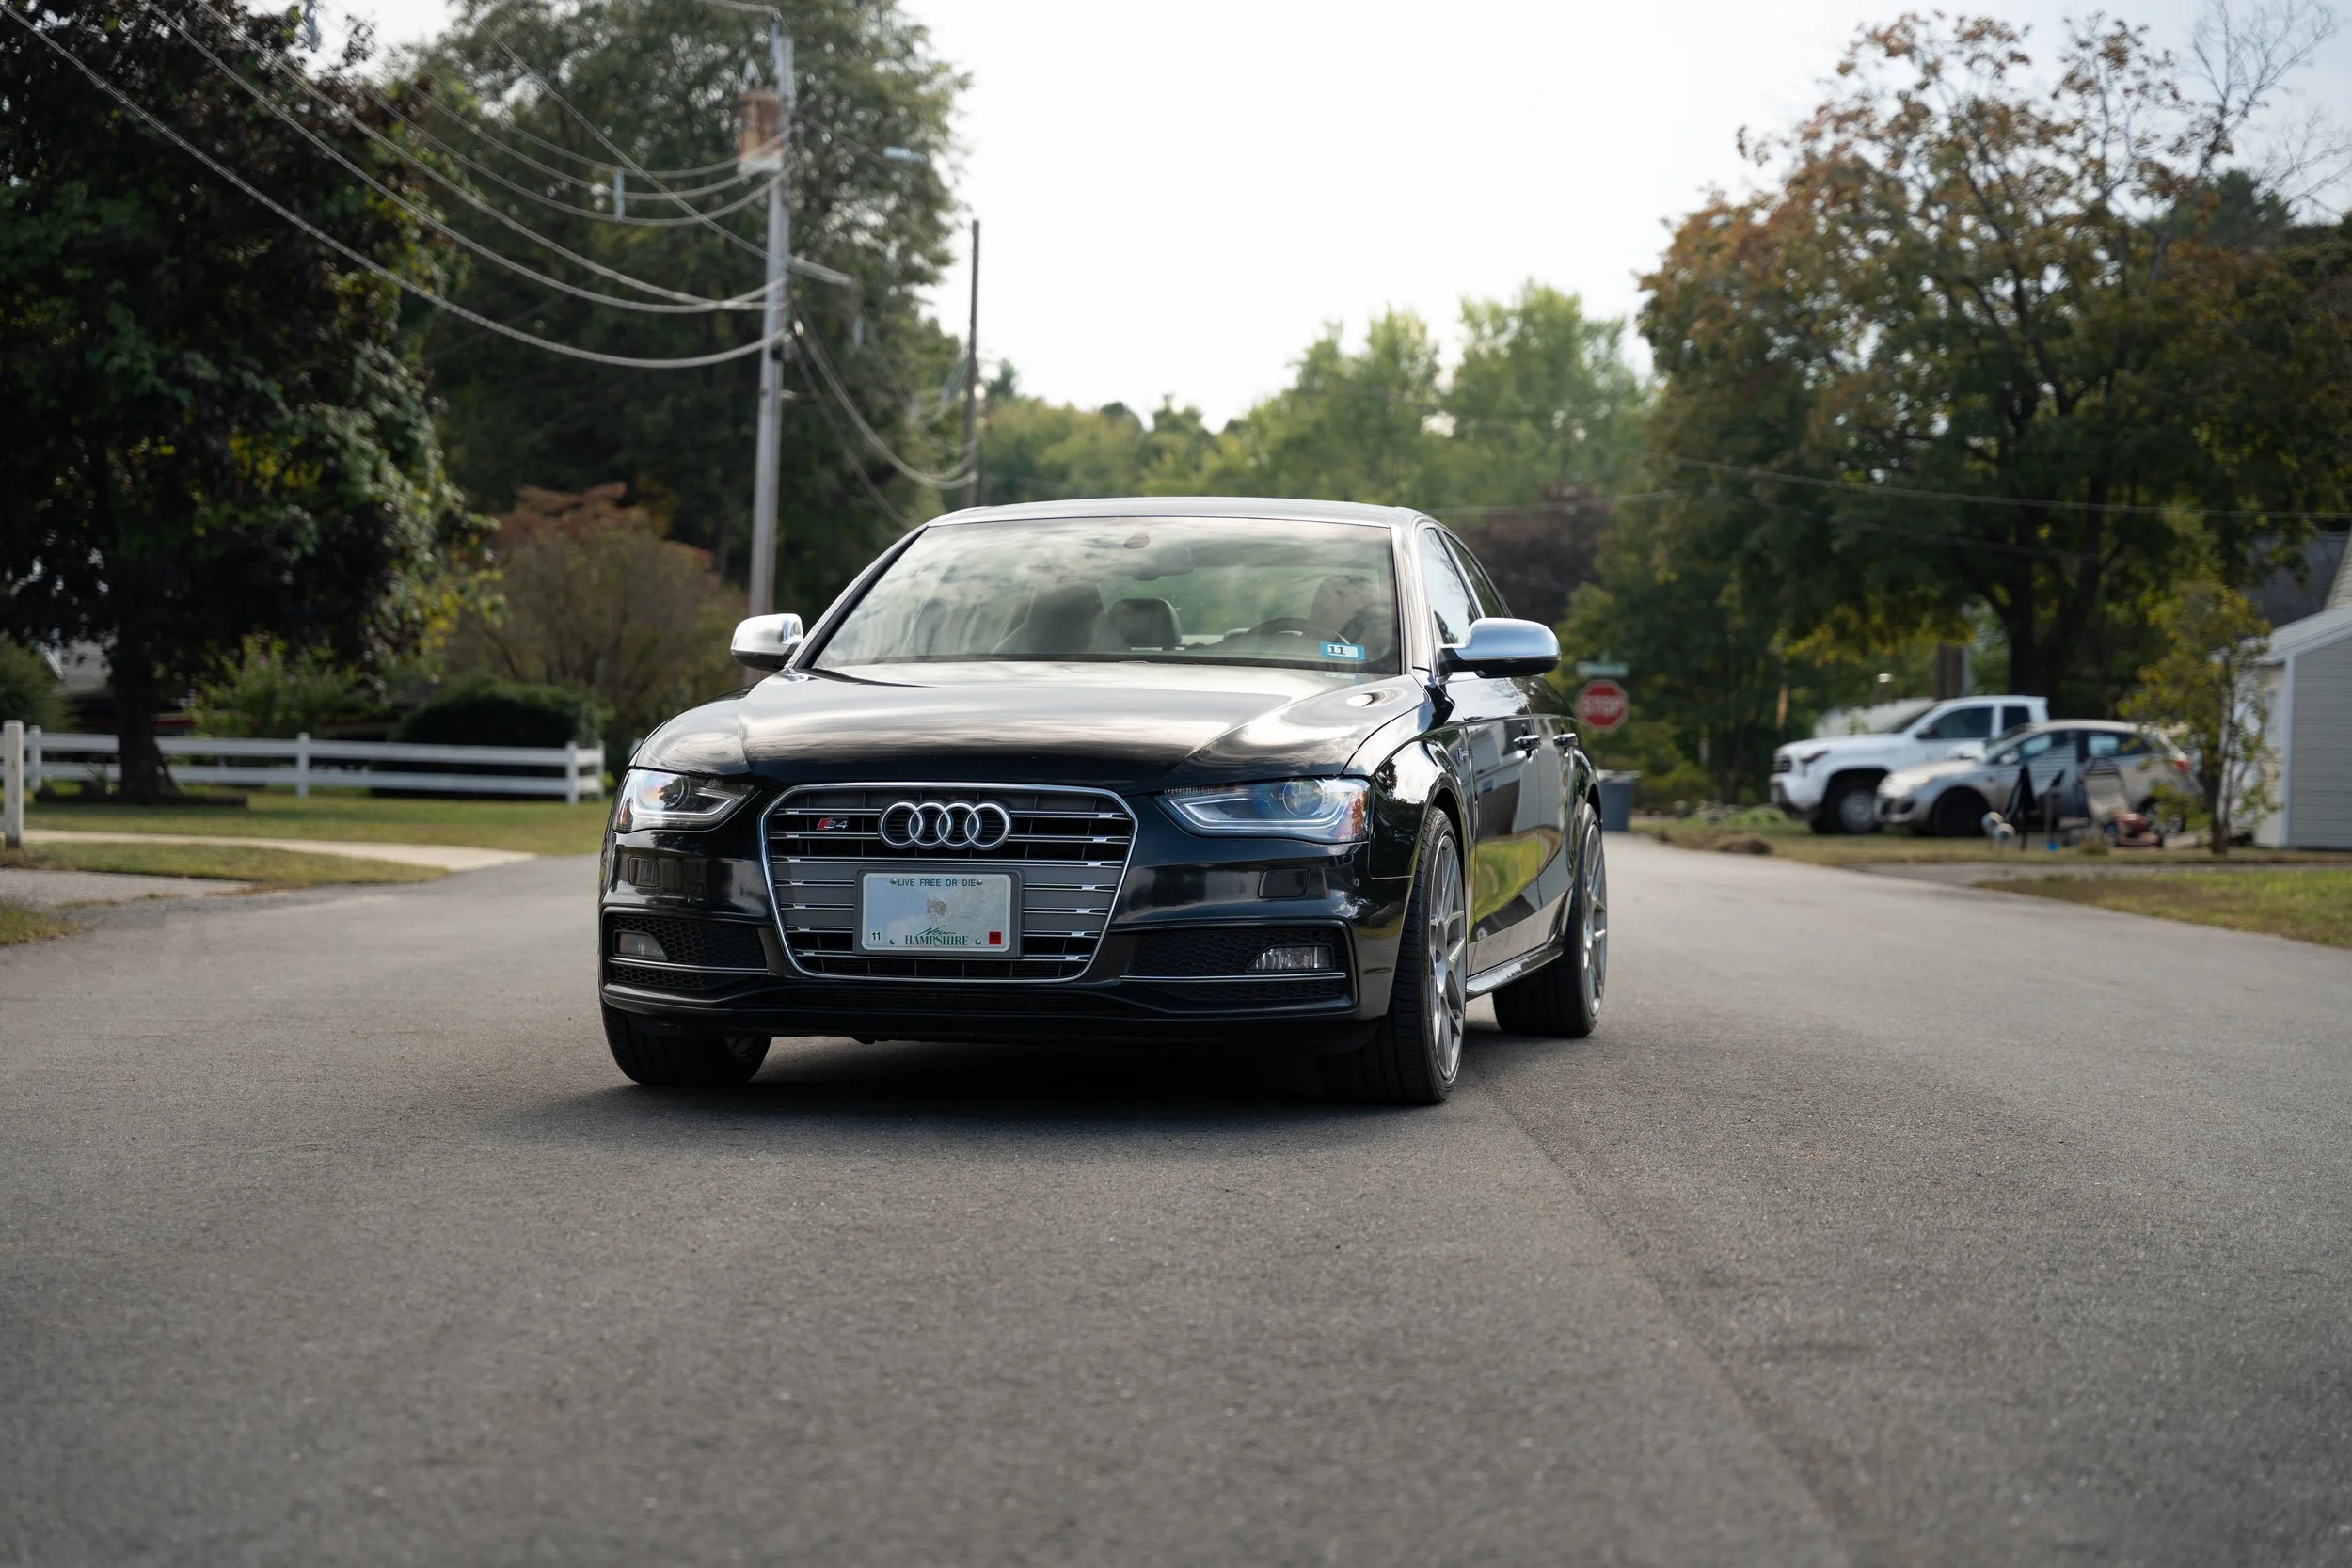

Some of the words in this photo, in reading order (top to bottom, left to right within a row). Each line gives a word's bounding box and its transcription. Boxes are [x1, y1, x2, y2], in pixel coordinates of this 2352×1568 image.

[1328, 645, 1346, 656] 11
[871, 931, 882, 941] 11
[916, 927, 956, 936] New
[905, 935, 969, 946] HAMPSHIRE
